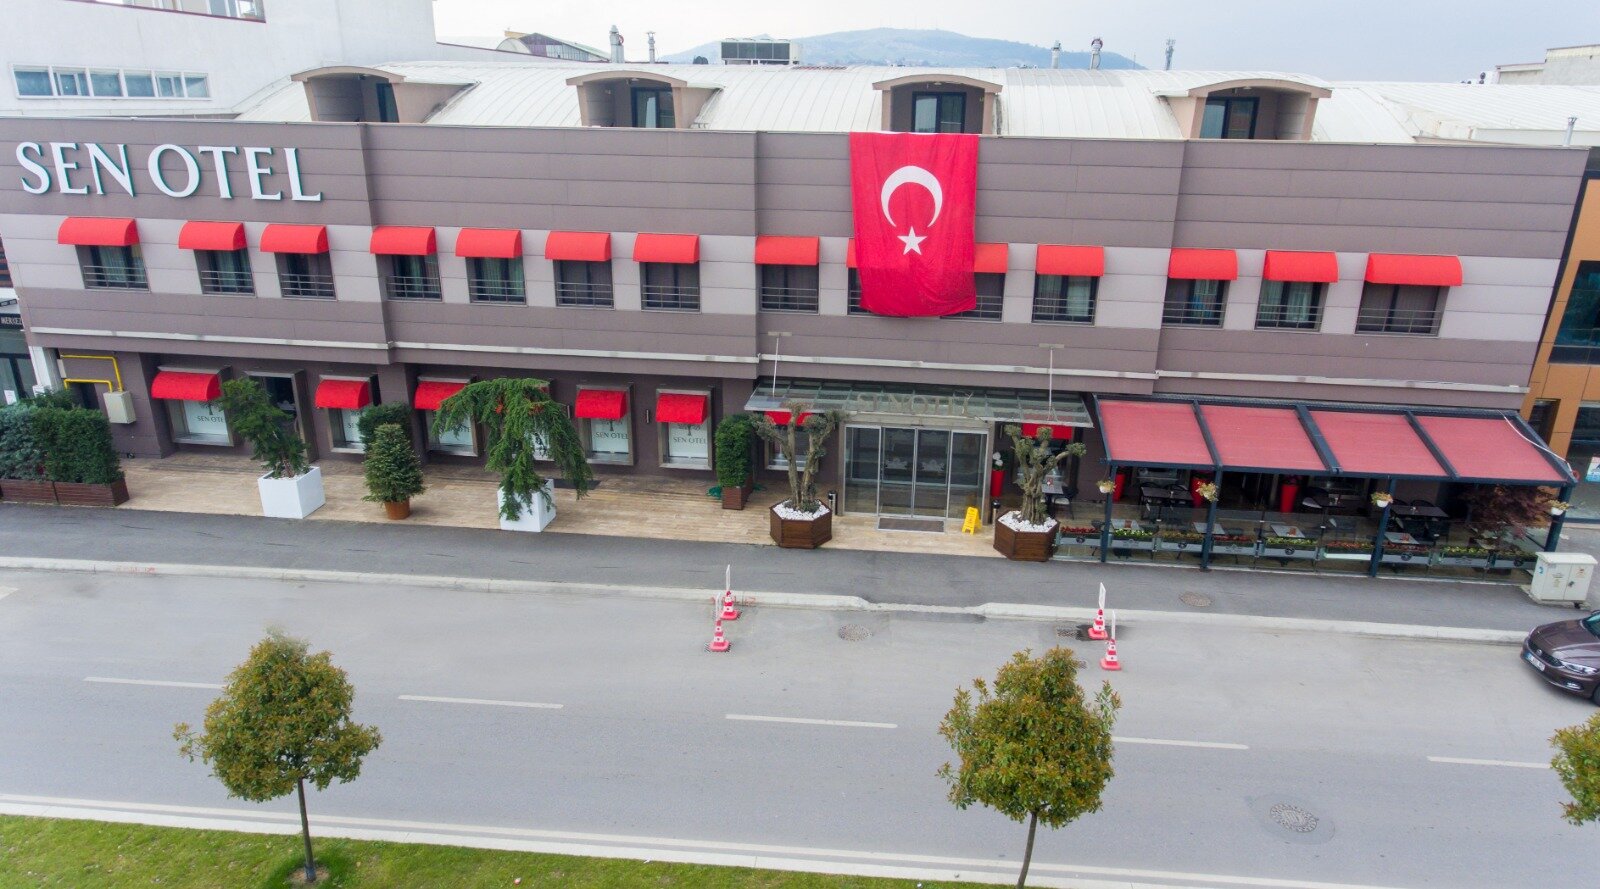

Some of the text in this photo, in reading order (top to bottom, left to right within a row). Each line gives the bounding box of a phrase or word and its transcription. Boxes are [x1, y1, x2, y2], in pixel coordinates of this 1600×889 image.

[15, 141, 323, 202] SEN OTEL
[610, 432, 629, 440] OTEL
